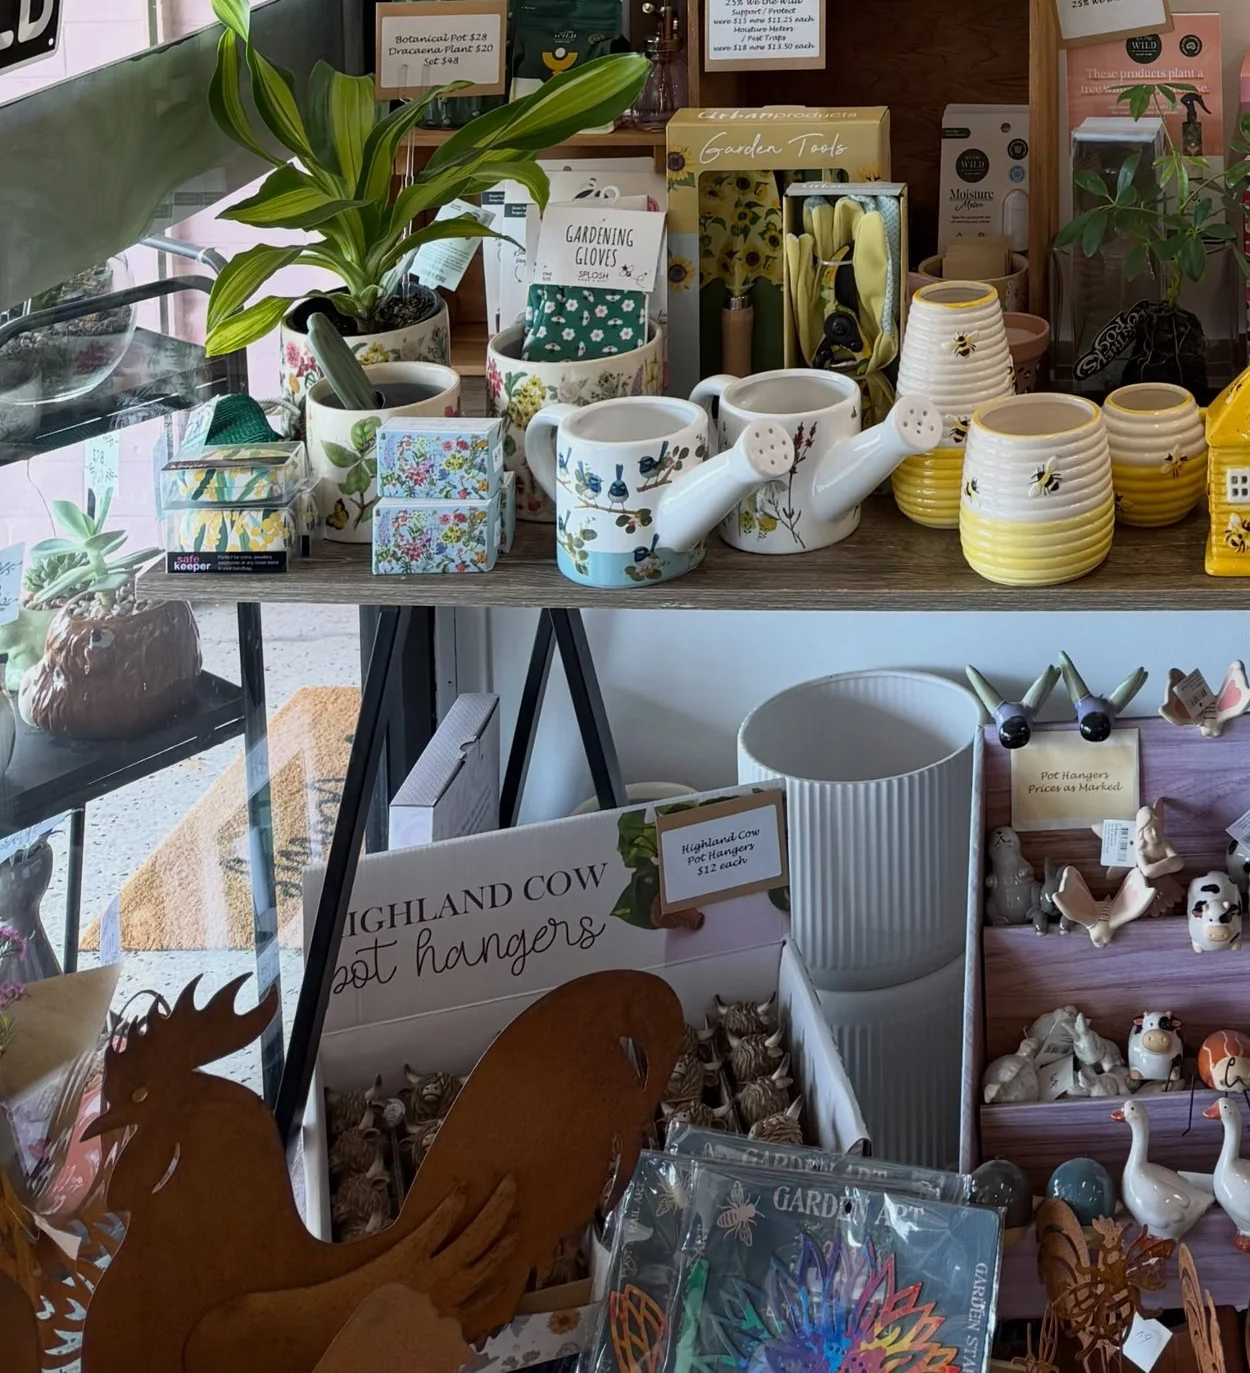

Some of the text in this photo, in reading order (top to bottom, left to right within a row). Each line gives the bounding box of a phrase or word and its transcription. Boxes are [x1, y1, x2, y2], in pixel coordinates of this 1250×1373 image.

[794, 15, 815, 23] each
[395, 32, 488, 45] Botanical Pot $28
[794, 41, 815, 49] each
[388, 44, 494, 56] Dracaena Plant $20
[1131, 41, 1157, 50] WILD
[424, 56, 460, 66] Set $48
[1086, 68, 1118, 79] These
[1119, 68, 1167, 82] products
[1168, 68, 1196, 82] plant
[700, 132, 849, 164] Garden Tools
[961, 161, 985, 169] WILD
[949, 188, 994, 201] Moisture
[565, 224, 634, 247] GARDENING
[575, 246, 618, 268] GLOVES
[578, 270, 609, 280] SPLOSH
[177, 554, 200, 564] safe
[173, 561, 212, 572] keeper
[1040, 771, 1109, 781] Pot Hangers
[1028, 782, 1123, 794] Prices as Marked
[681, 828, 761, 855] Highland Cow
[687, 843, 756, 867] Pot Hangers
[696, 857, 748, 877] $12 each
[343, 862, 609, 939] IGHLAND COW
[416, 913, 607, 977] hangers
[773, 1186, 925, 1228] GARDEN ART
[967, 1261, 989, 1331] GARDEN
